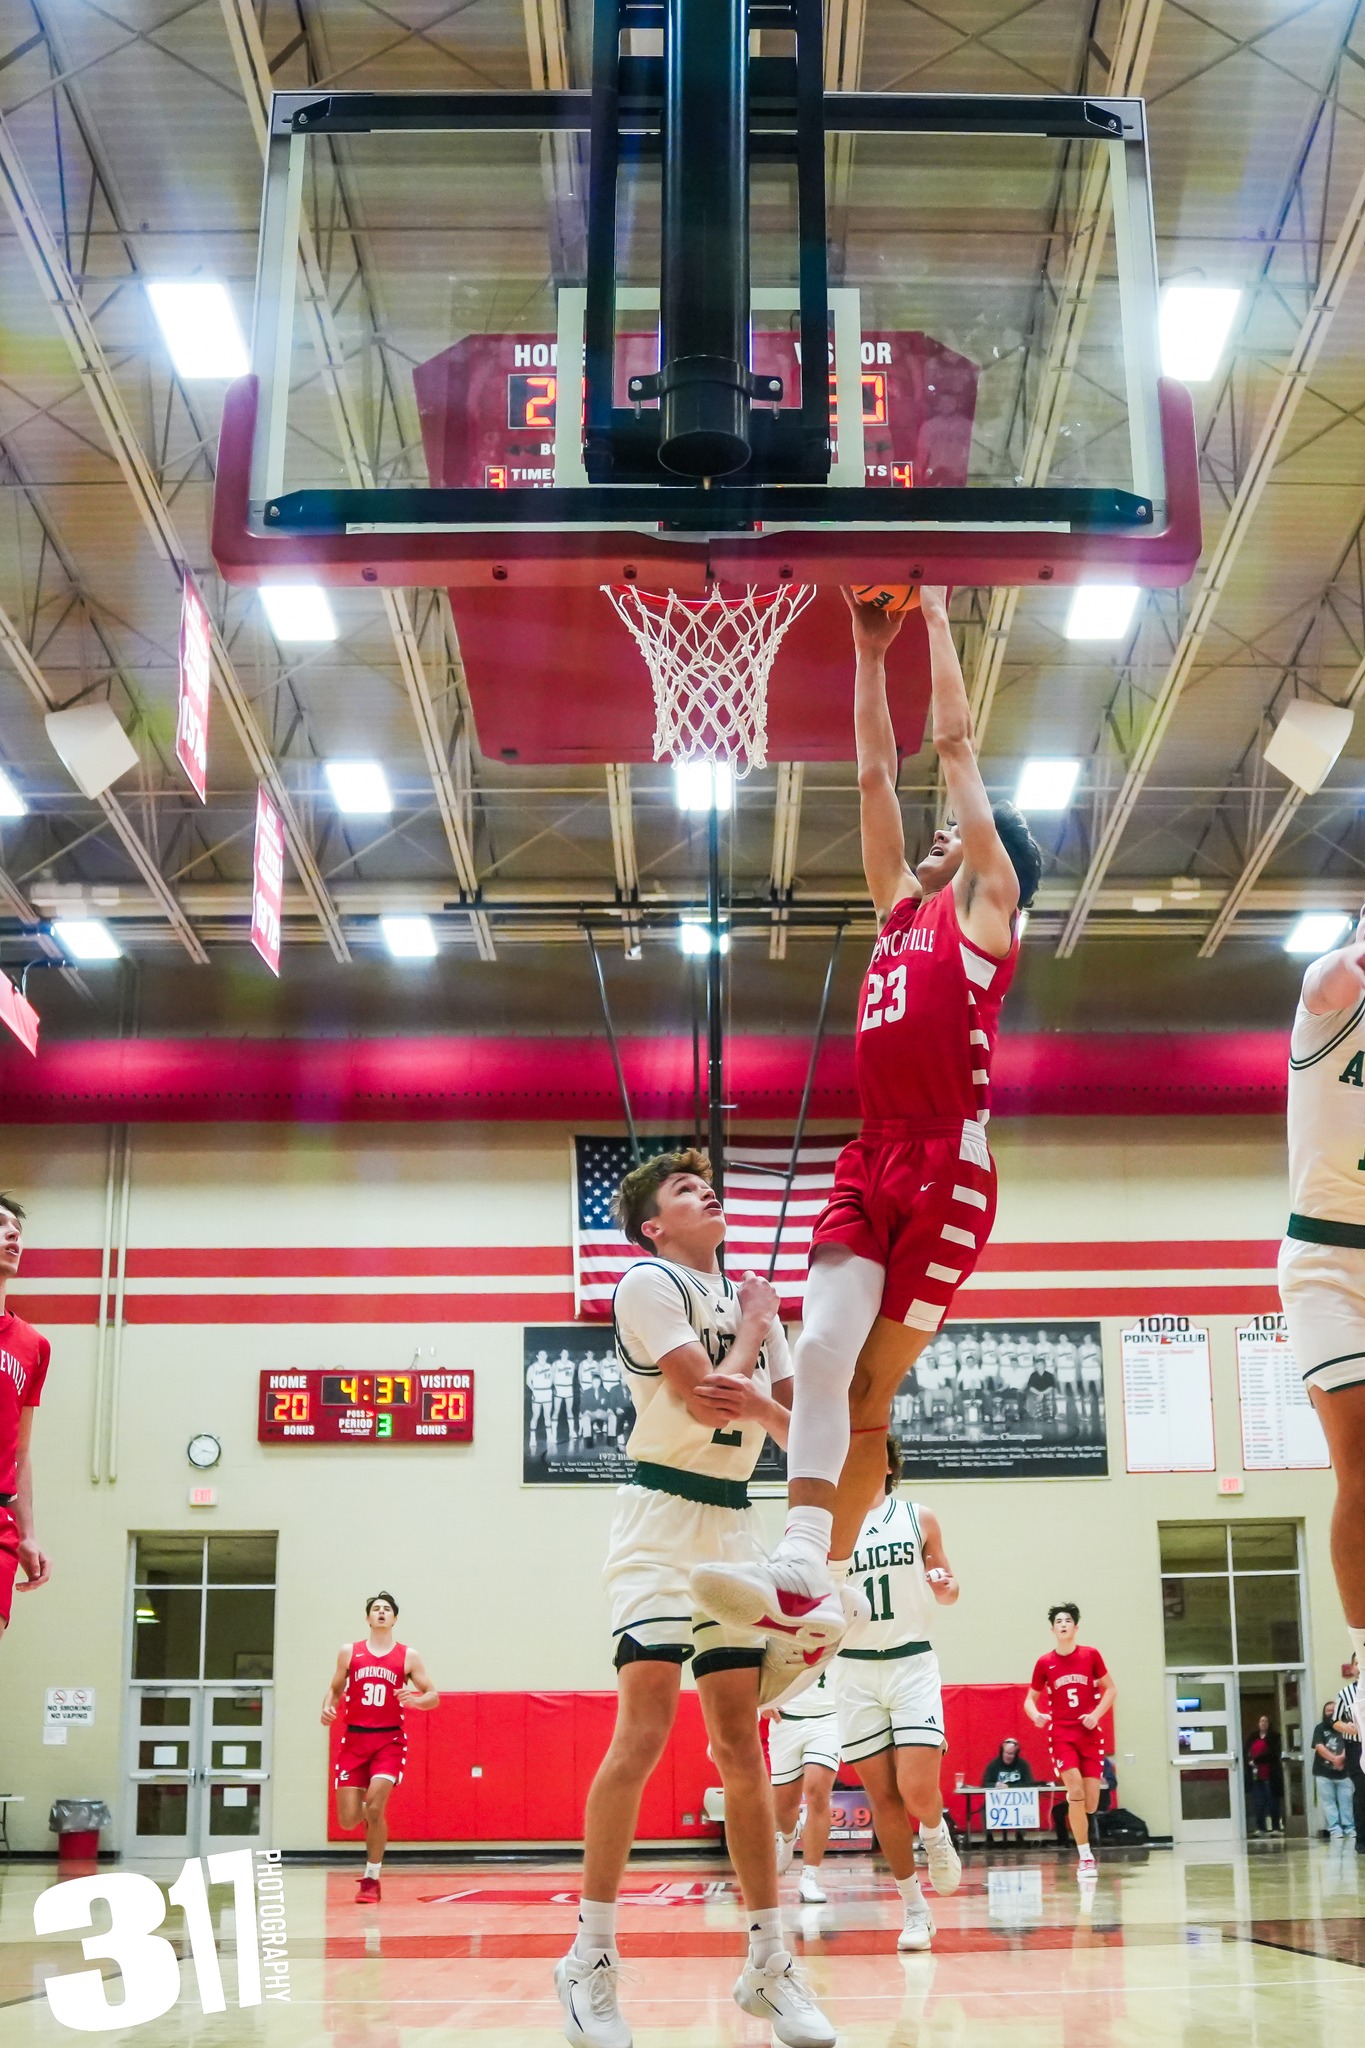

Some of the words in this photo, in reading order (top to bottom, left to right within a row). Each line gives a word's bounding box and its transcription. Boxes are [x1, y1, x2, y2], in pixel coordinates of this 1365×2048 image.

[860, 964, 907, 1032] 23
[1138, 1316, 1190, 1333] 1000
[1254, 1315, 1288, 1331] 100
[1124, 1334, 1160, 1344] POINT
[1176, 1334, 1206, 1343] CLUB
[1239, 1333, 1275, 1342] POINT
[269, 1375, 307, 1389] HOME
[340, 1377, 410, 1404] 4:37
[420, 1375, 470, 1389] VISITOR
[274, 1394, 307, 1421] 20
[346, 1410, 365, 1418] POSS
[430, 1394, 464, 1420] 20
[283, 1425, 315, 1435] BONUS
[338, 1418, 373, 1429] PERIOD
[377, 1413, 392, 1437] 3
[416, 1425, 447, 1435] BONUS
[846, 1542, 914, 1576] LICES
[863, 1573, 894, 1622] 11
[354, 1665, 398, 1686] LAWRENCEVILLE
[361, 1682, 386, 1707] 30
[1066, 1688, 1079, 1708] 5
[989, 1791, 1034, 1806] WZDM
[830, 1807, 872, 1828] 2.9
[989, 1807, 1020, 1828] 92.1
